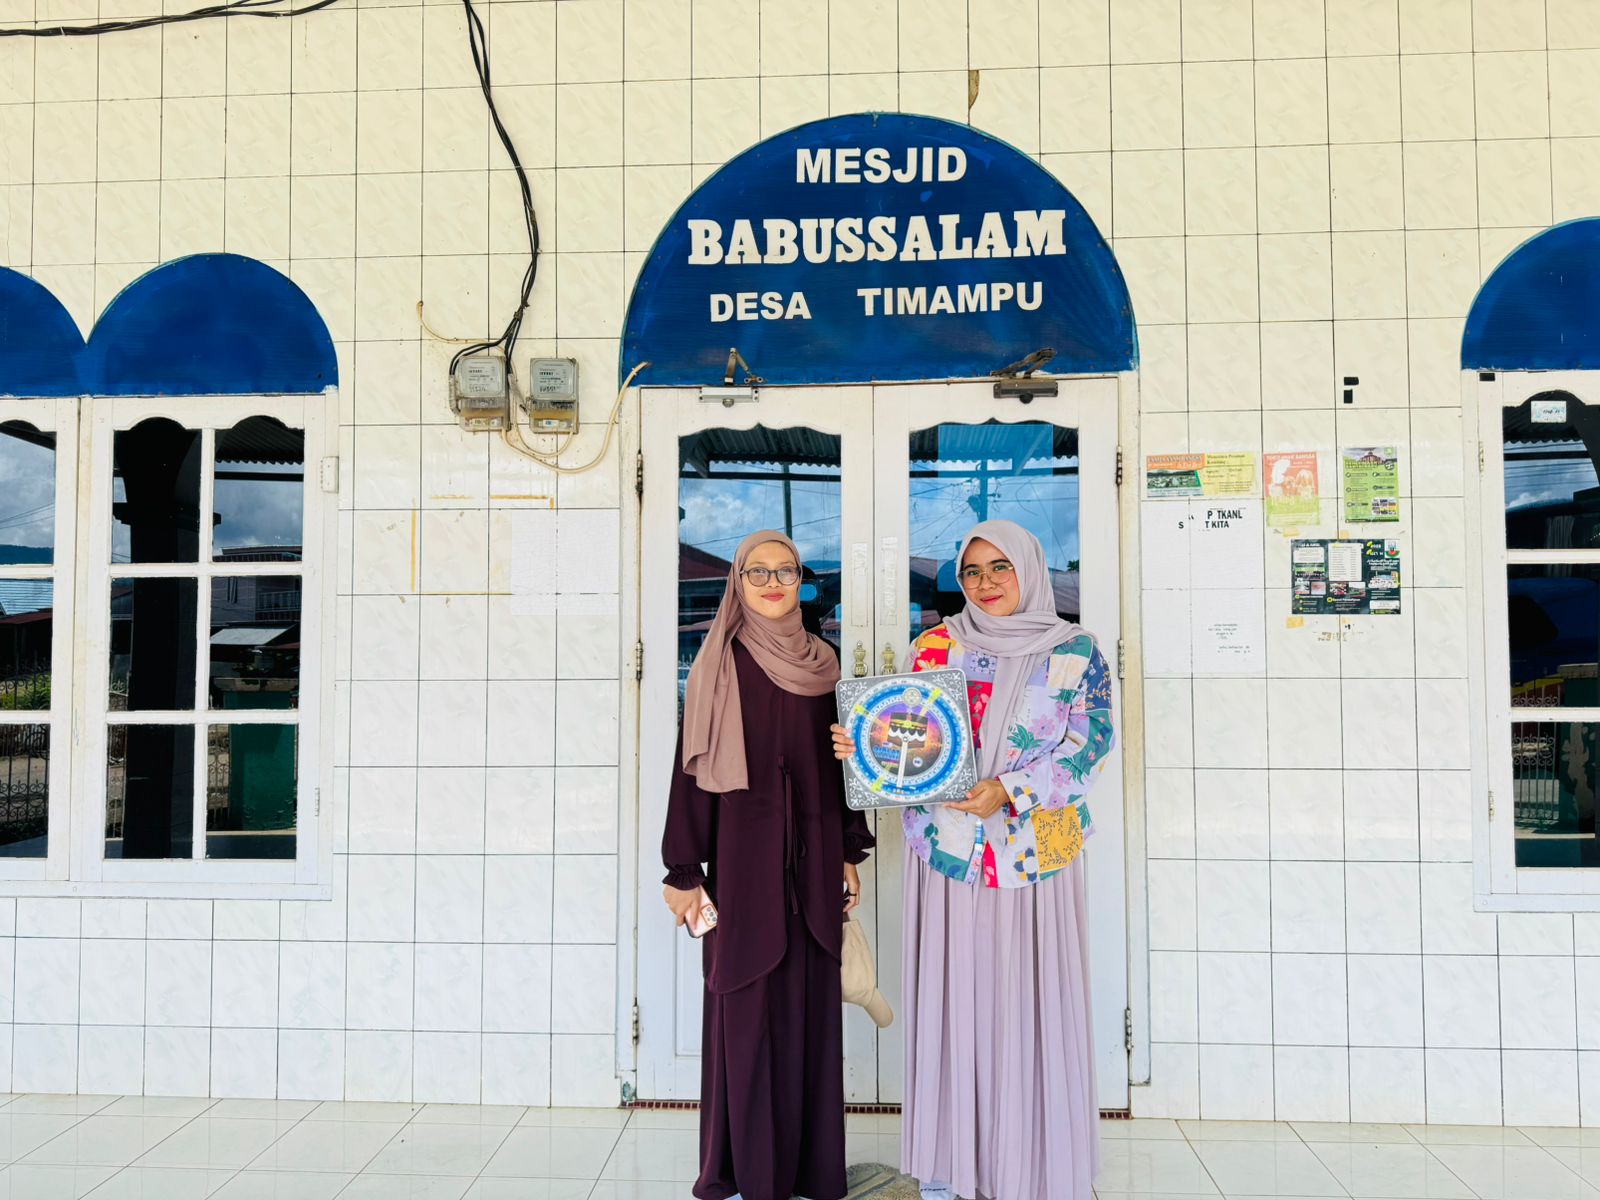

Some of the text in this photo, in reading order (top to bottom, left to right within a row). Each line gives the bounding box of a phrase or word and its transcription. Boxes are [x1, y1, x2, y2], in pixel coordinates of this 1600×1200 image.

[796, 147, 967, 184] MESJID
[687, 209, 1067, 266] BABUSSALAM
[709, 281, 1044, 322] DESA TIMAMPU
[1211, 520, 1230, 528] KITA
